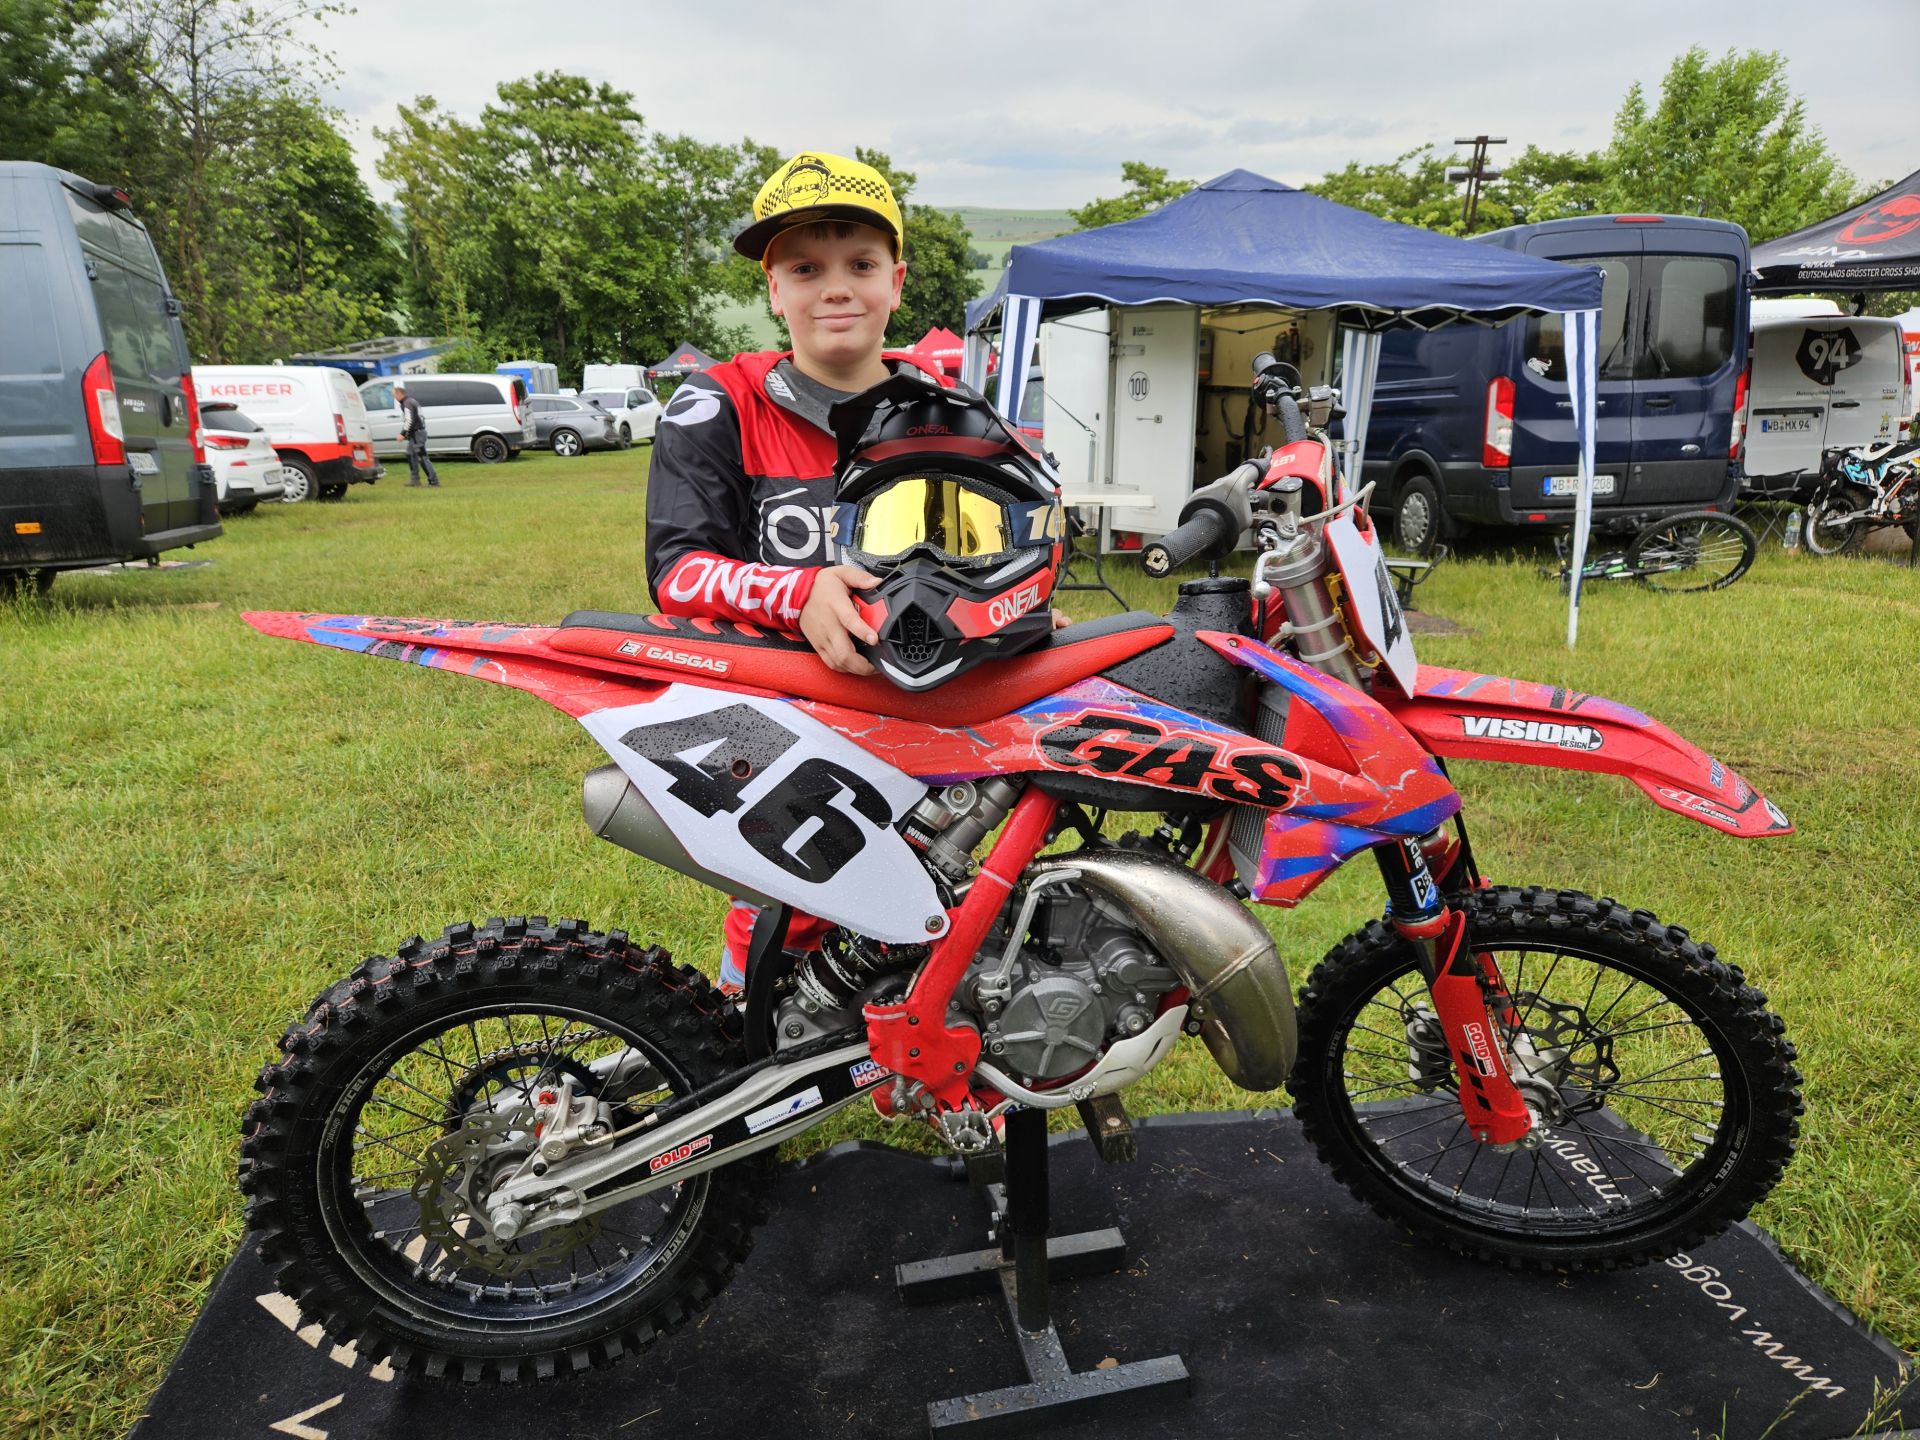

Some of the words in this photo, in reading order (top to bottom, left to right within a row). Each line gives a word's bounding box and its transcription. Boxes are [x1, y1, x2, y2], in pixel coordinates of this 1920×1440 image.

[1881, 267, 1903, 277] CROSS
[932, 348, 964, 356] MOTU
[1808, 338, 1849, 370] 94
[210, 383, 293, 396] KAEFER
[1130, 377, 1147, 396] 100
[1768, 420, 1779, 430] WB
[1785, 420, 1797, 430] MX
[1798, 420, 1810, 430] 94
[1552, 479, 1565, 490] WB
[1593, 478, 1611, 490] 208
[646, 646, 729, 673] GASGAS
[1463, 716, 1593, 744] VISION
[1559, 740, 1588, 750] DESIGN
[1039, 714, 1303, 808] GAS
[617, 702, 893, 884] 46
[1467, 1022, 1490, 1060] GOLD
[337, 1077, 368, 1115] EXCEL
[650, 1144, 692, 1170] GOLD
[1714, 1150, 1738, 1180] EXCEL
[657, 1228, 687, 1263] EXCEL
